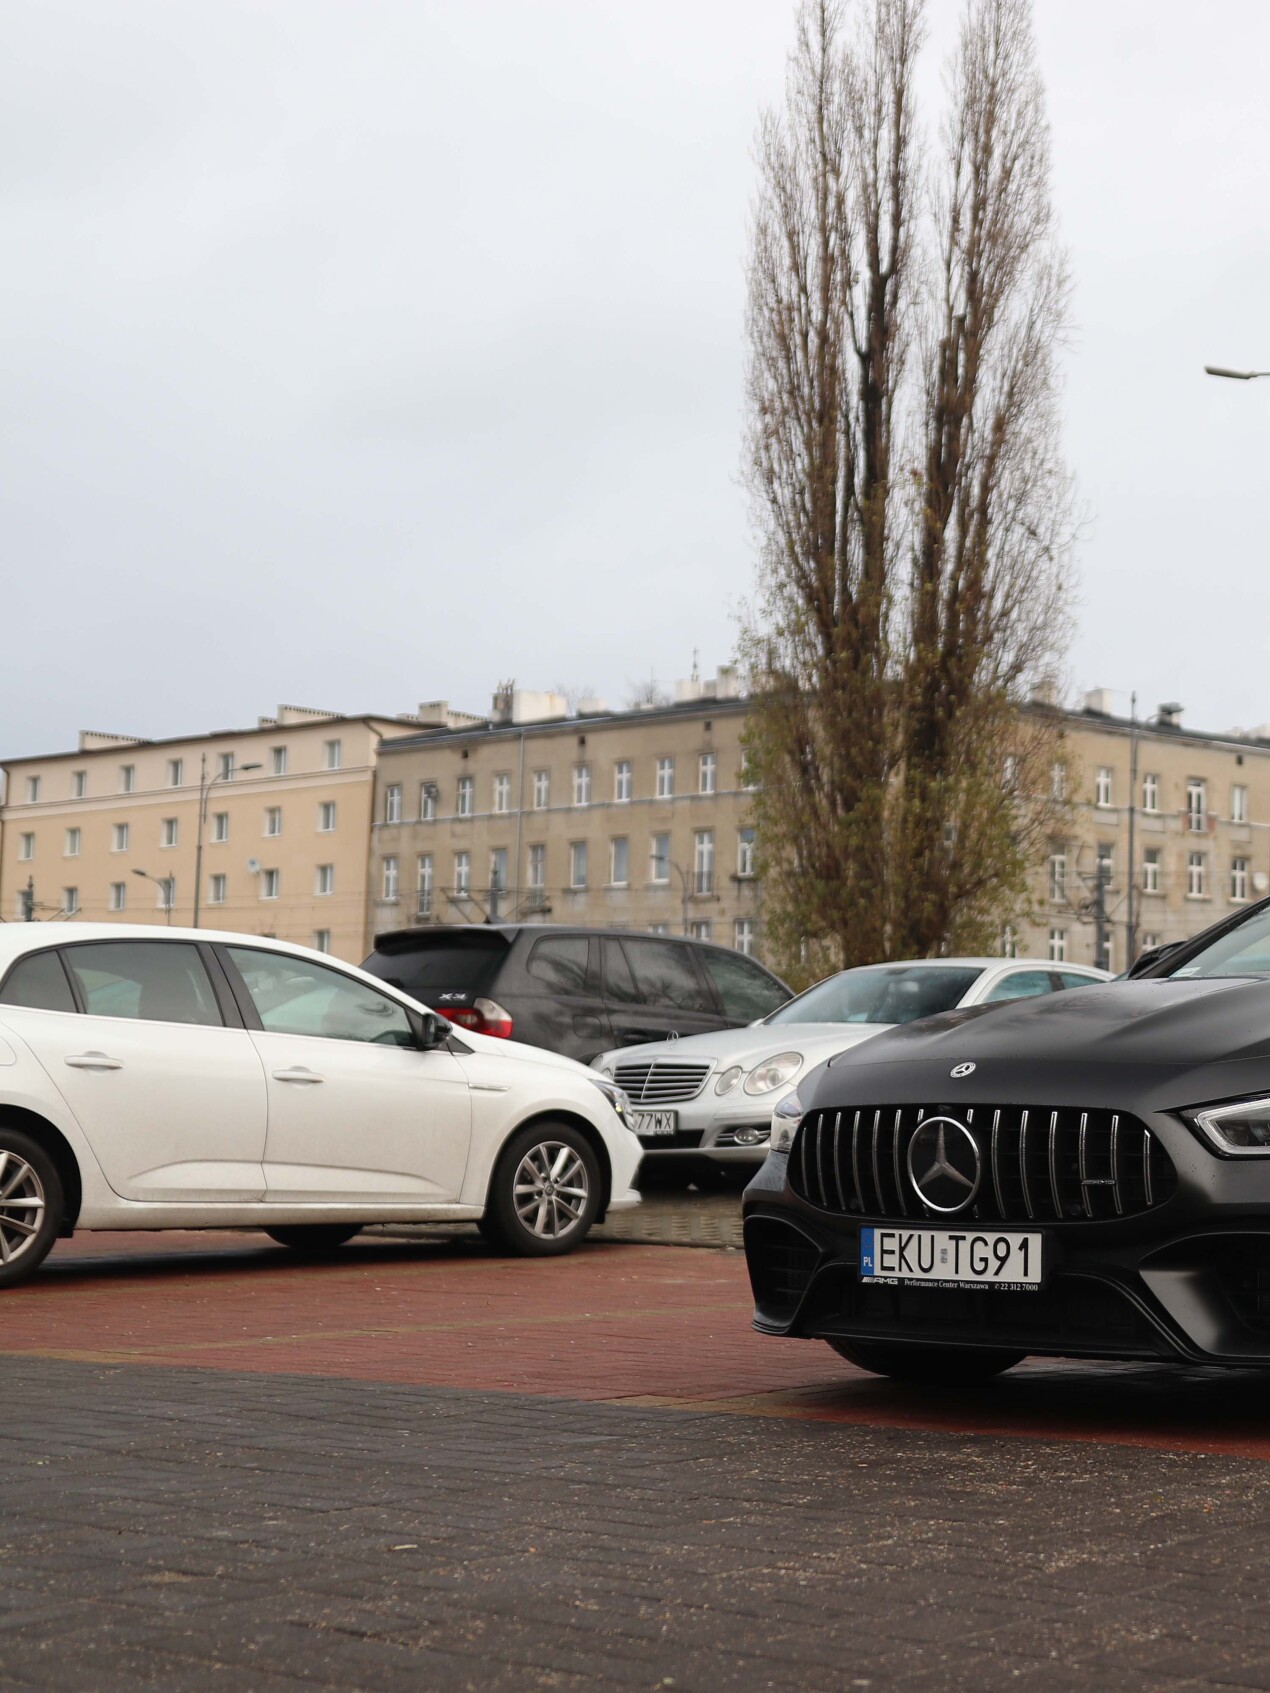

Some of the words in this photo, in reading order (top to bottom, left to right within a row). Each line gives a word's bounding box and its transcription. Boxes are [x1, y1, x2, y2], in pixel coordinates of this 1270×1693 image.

[863, 1256, 873, 1267] PL
[880, 1233, 935, 1274] EKU
[948, 1234, 1029, 1278] TG91
[869, 1277, 899, 1285] AMG
[904, 1278, 938, 1288] Performance
[938, 1280, 958, 1288] Center
[959, 1281, 989, 1290] Warszawa
[1009, 1283, 1021, 1291] 312
[1022, 1283, 1039, 1291] 7000
